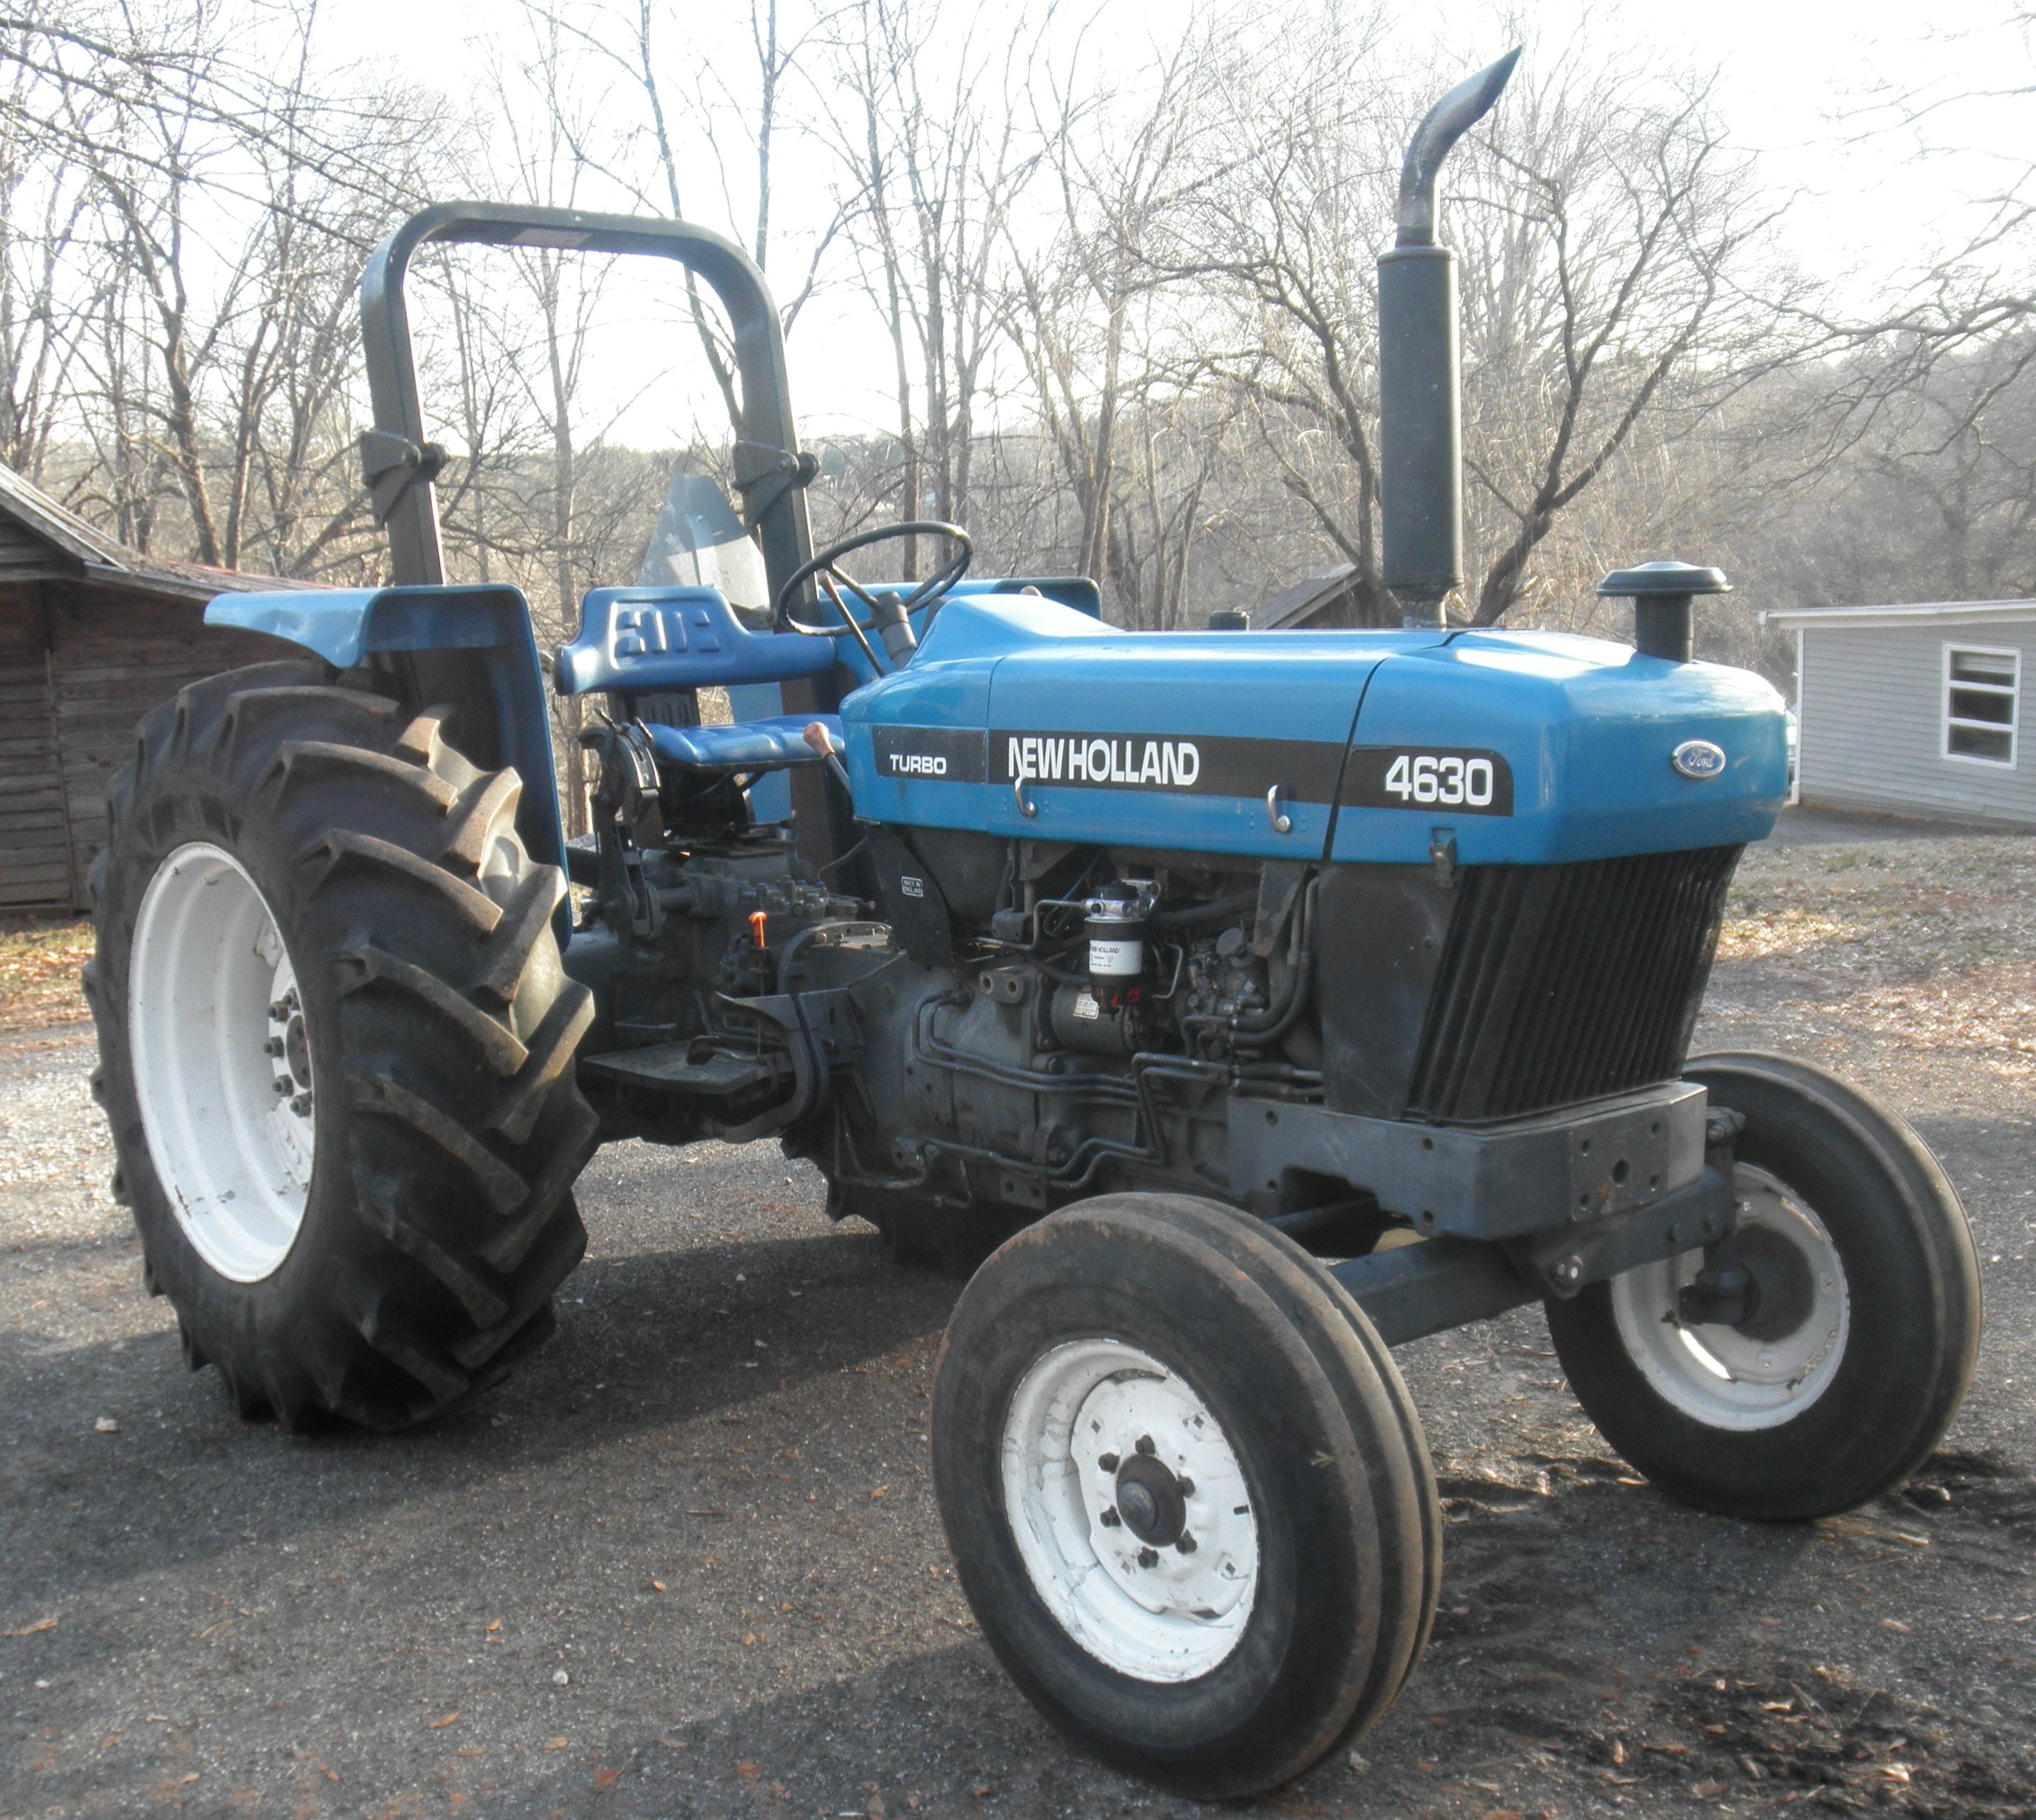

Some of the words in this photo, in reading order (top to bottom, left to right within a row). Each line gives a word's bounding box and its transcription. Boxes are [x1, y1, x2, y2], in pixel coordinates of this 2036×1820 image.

[889, 754, 947, 775] TURBO
[1008, 737, 1065, 779] NEW
[1068, 738, 1200, 786] HOLLAND
[1689, 747, 1714, 769] Ford
[1385, 755, 1494, 806] 4630
